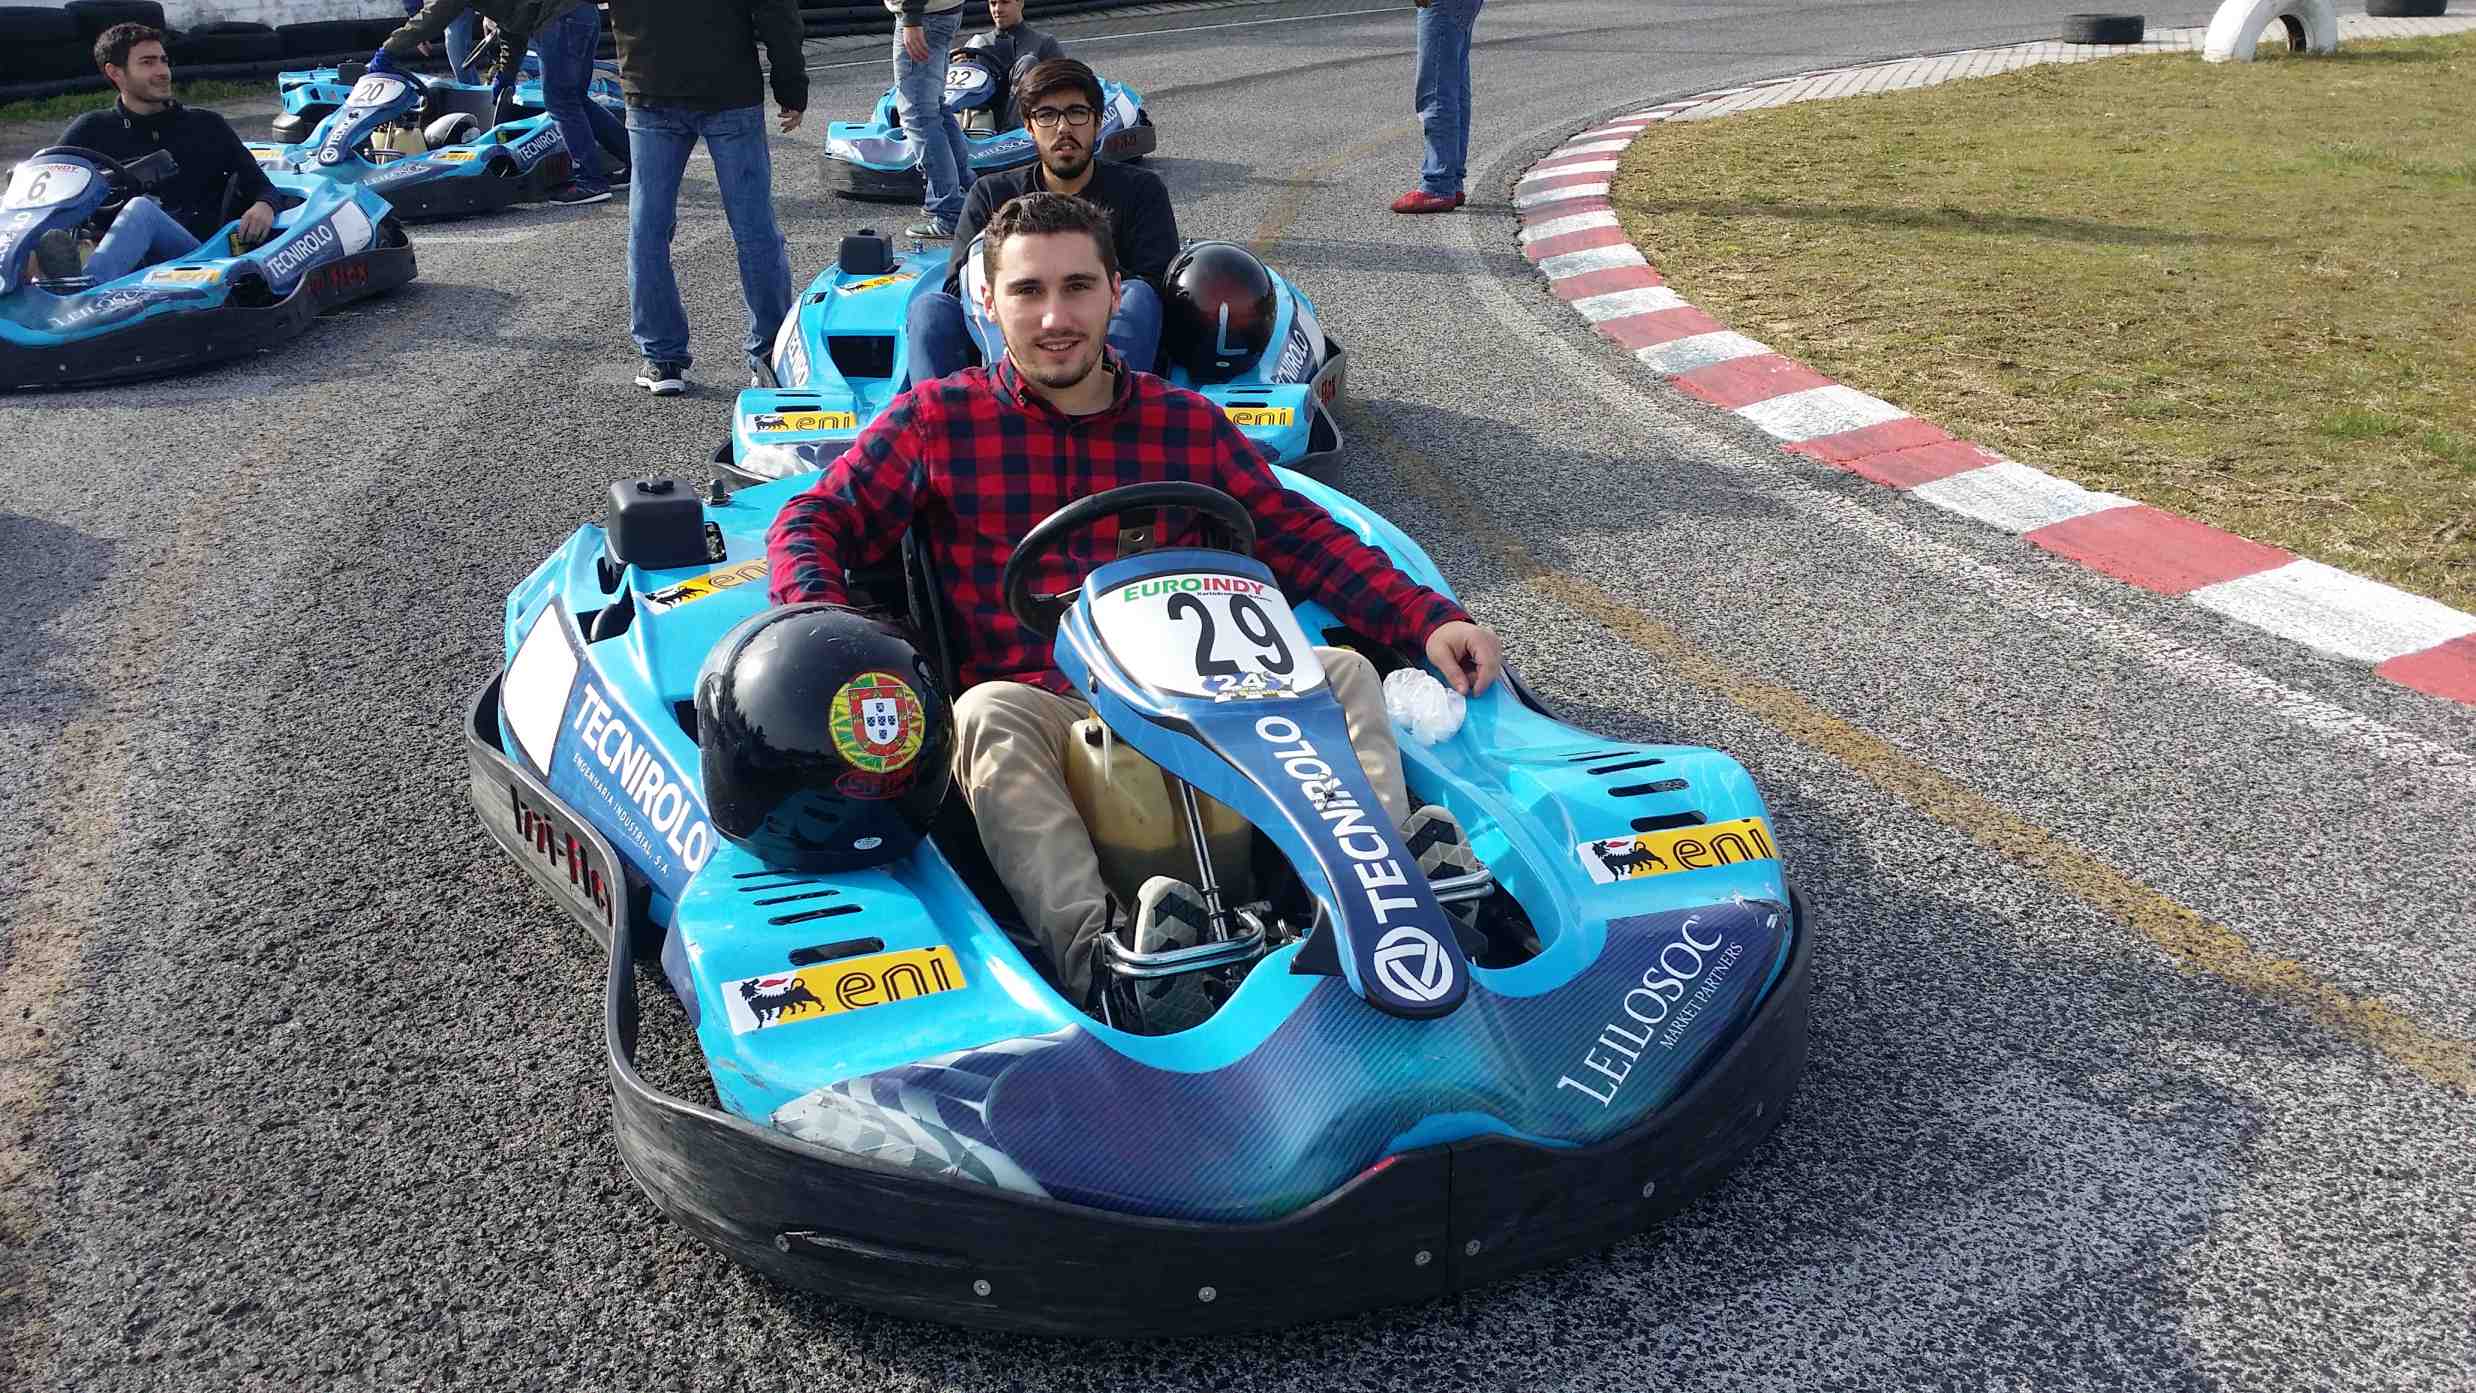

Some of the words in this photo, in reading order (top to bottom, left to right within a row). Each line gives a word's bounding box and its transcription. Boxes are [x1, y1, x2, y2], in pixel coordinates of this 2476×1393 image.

[358, 83, 385, 101] 20
[949, 70, 971, 86] 32
[519, 127, 564, 160] TECNIROL
[28, 171, 51, 200] 6
[267, 224, 334, 279] TECNIROLO
[796, 411, 850, 430] eni
[1232, 407, 1287, 426] eni
[708, 559, 768, 589] en
[1124, 578, 1264, 602] EUROINDY
[1167, 592, 1294, 676] 29
[573, 683, 707, 873] TECNIROLO
[1255, 716, 1418, 925] TECNIROLO
[1672, 818, 1774, 870] eni
[835, 947, 954, 1011] eni
[1660, 999, 1702, 1050] MARKET
[1694, 942, 1744, 1004] PARTNERS
[1557, 916, 1722, 1108] LEILOSOC
